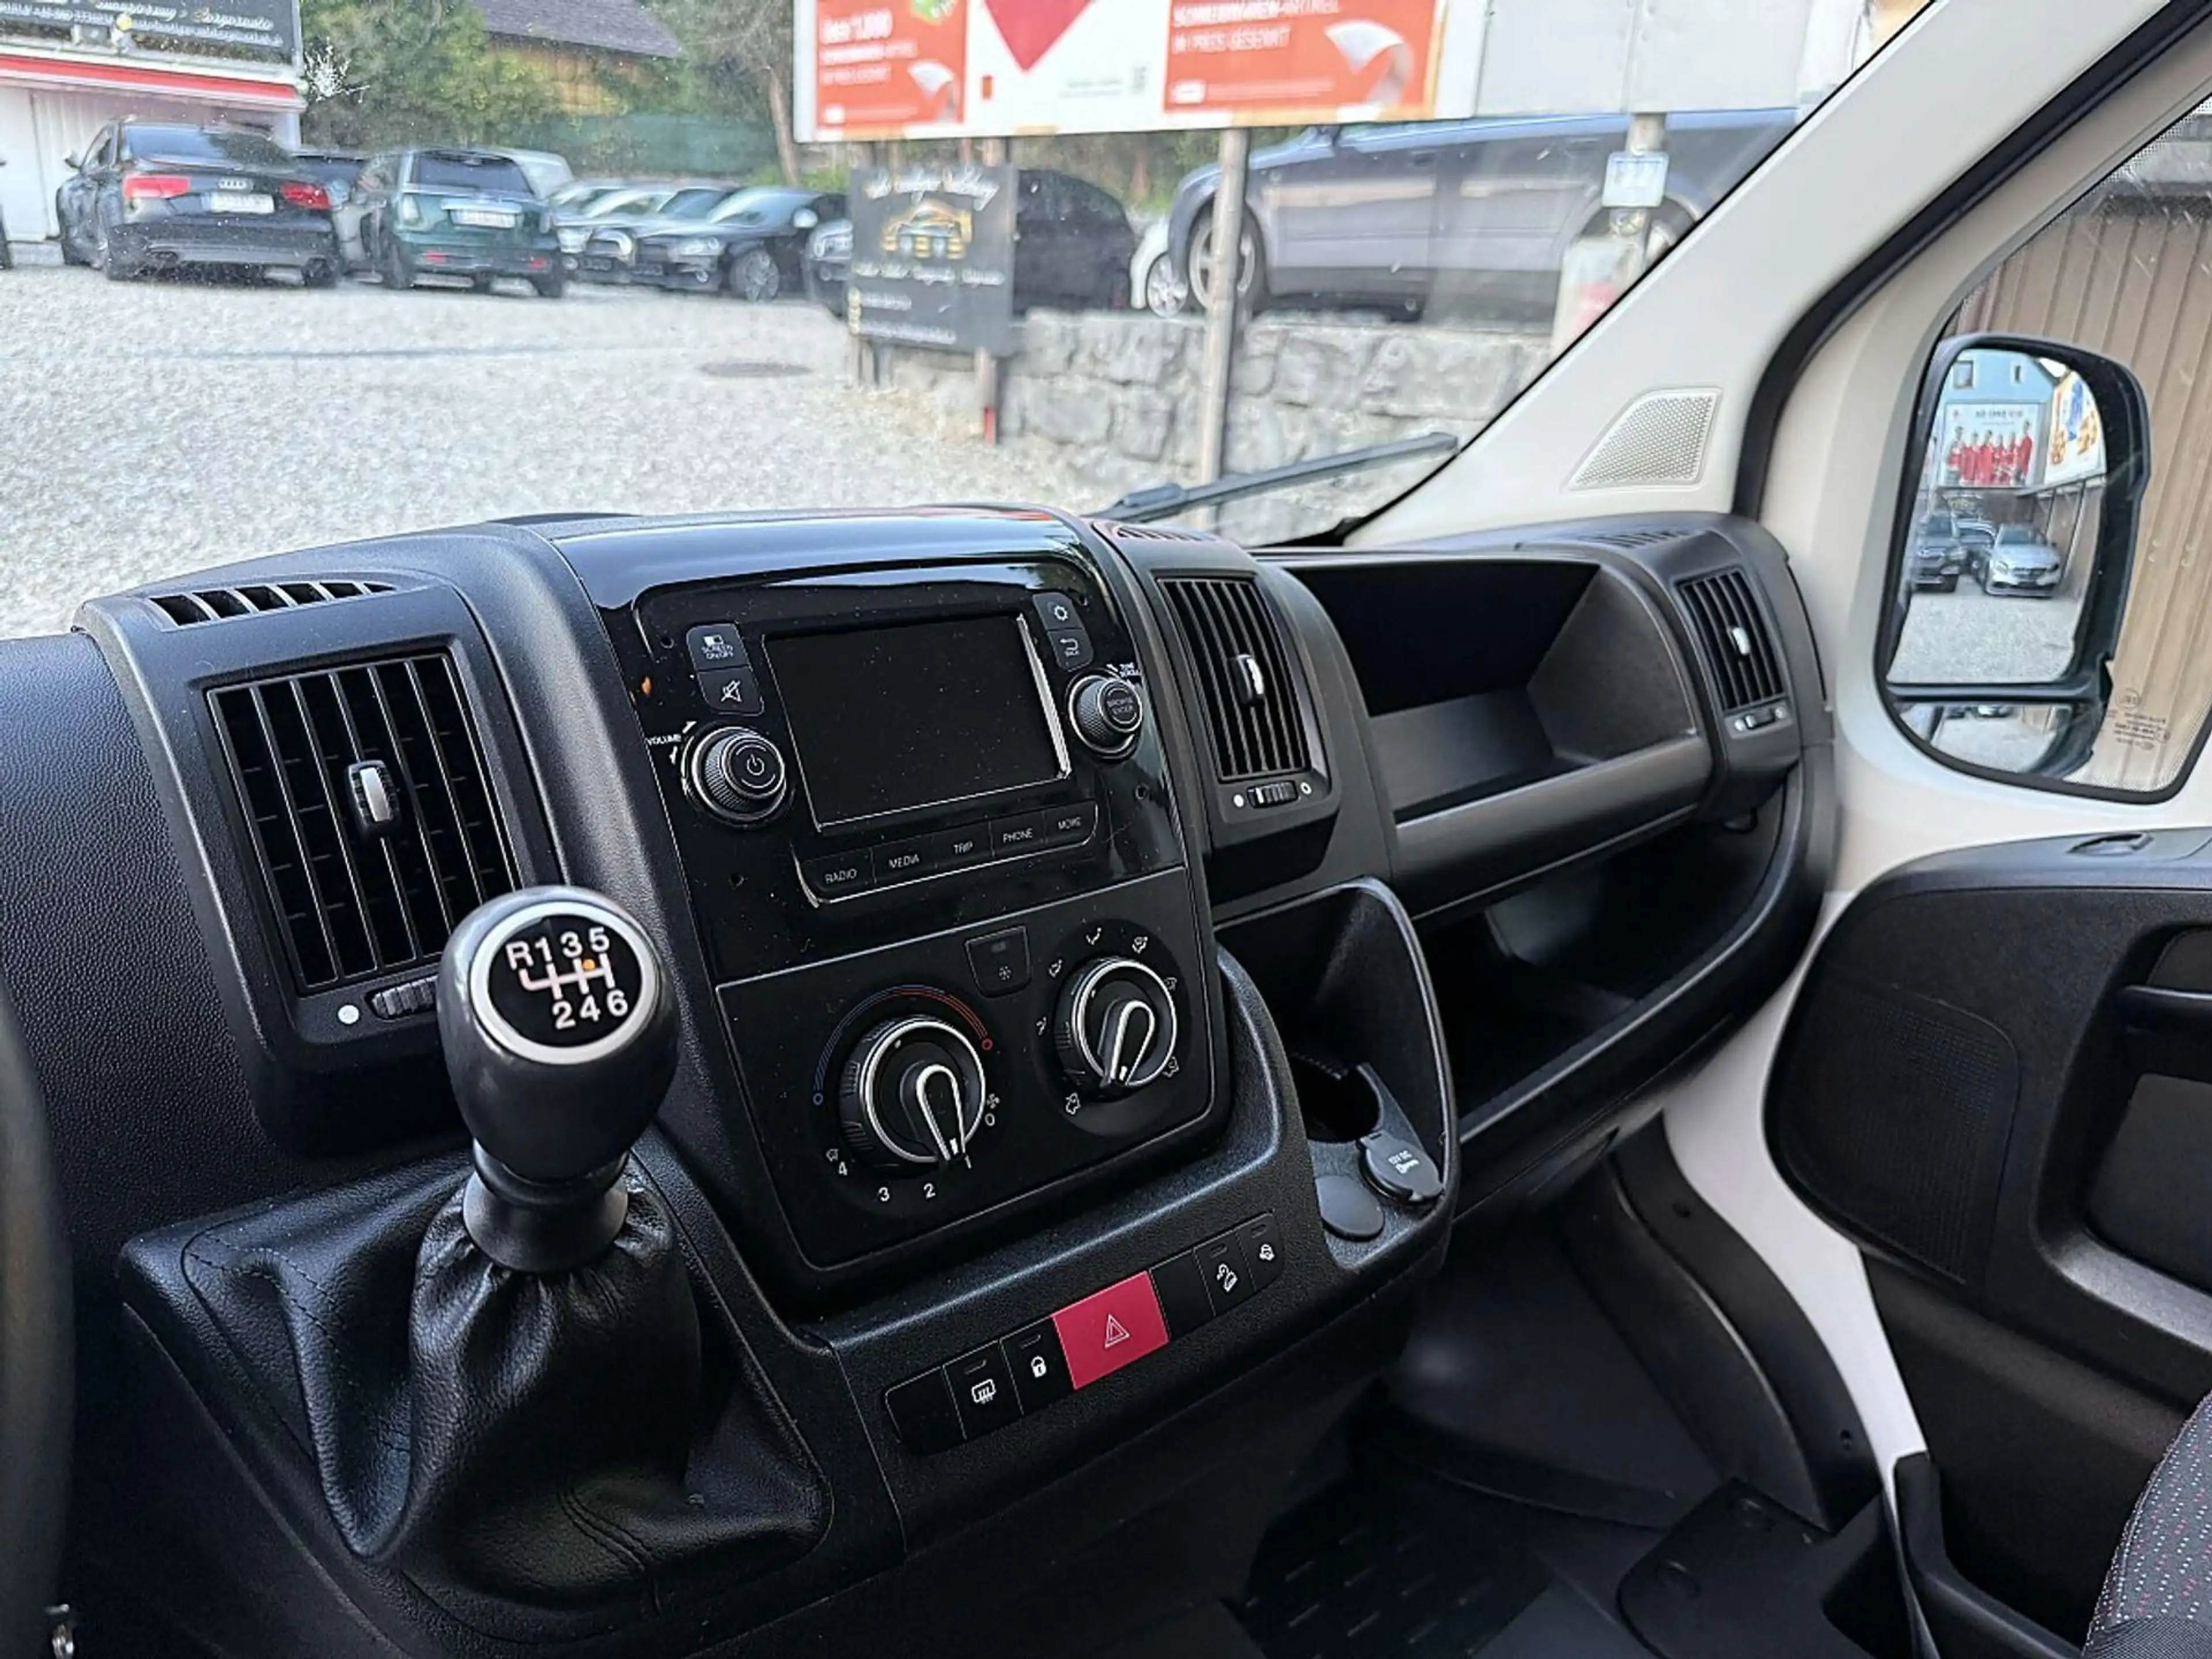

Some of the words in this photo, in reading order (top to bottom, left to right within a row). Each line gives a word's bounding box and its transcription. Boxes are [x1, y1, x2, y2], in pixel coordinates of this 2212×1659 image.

[647, 733, 682, 745] VOLUME
[825, 869, 857, 884] RADIO
[888, 853, 920, 868] MEDIA
[953, 841, 974, 854] TRIP
[1002, 828, 1033, 843] PHONE
[1057, 817, 1082, 830] MORE
[505, 941, 534, 970] R
[535, 936, 552, 962] 1
[560, 931, 582, 957] 3
[589, 926, 609, 952] 5
[552, 1001, 576, 1029] 2
[579, 995, 601, 1022] 4
[607, 990, 628, 1017] 6
[838, 1161, 848, 1176] 4
[878, 1186, 890, 1202] 3
[924, 1183, 936, 1199] 2
[984, 1113, 995, 1127] 0
